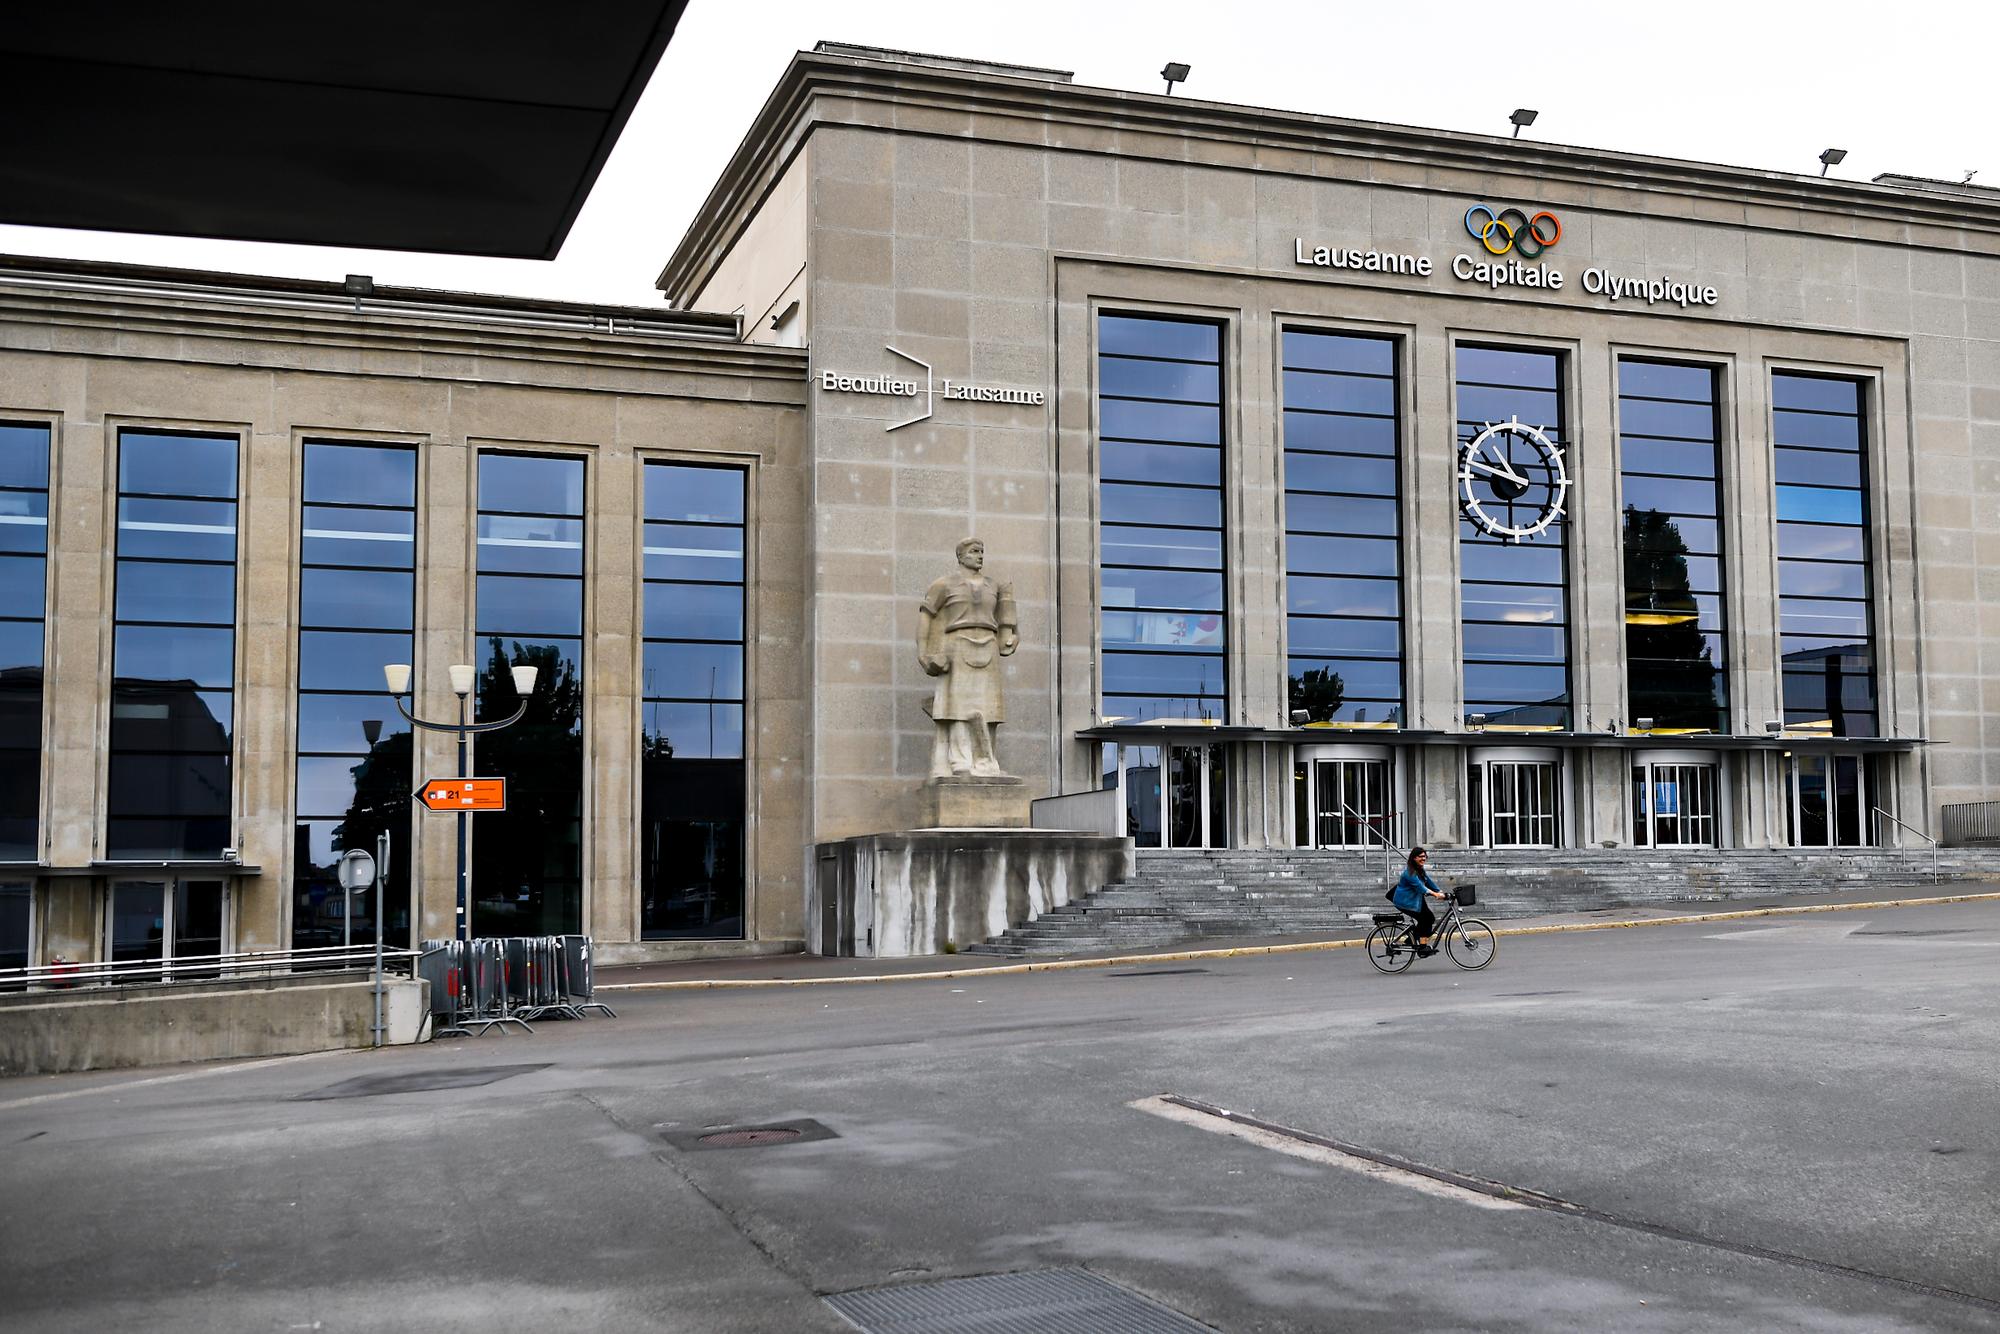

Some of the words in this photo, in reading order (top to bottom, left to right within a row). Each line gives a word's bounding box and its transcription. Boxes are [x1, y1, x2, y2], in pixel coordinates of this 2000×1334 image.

[1295, 238, 1433, 276] Lausanne
[1452, 253, 1563, 290] Capitale
[1583, 268, 1719, 308] Olympique
[822, 369, 917, 396] Beaulieu
[943, 379, 1045, 405] Lausanne
[447, 790, 460, 800] 21
